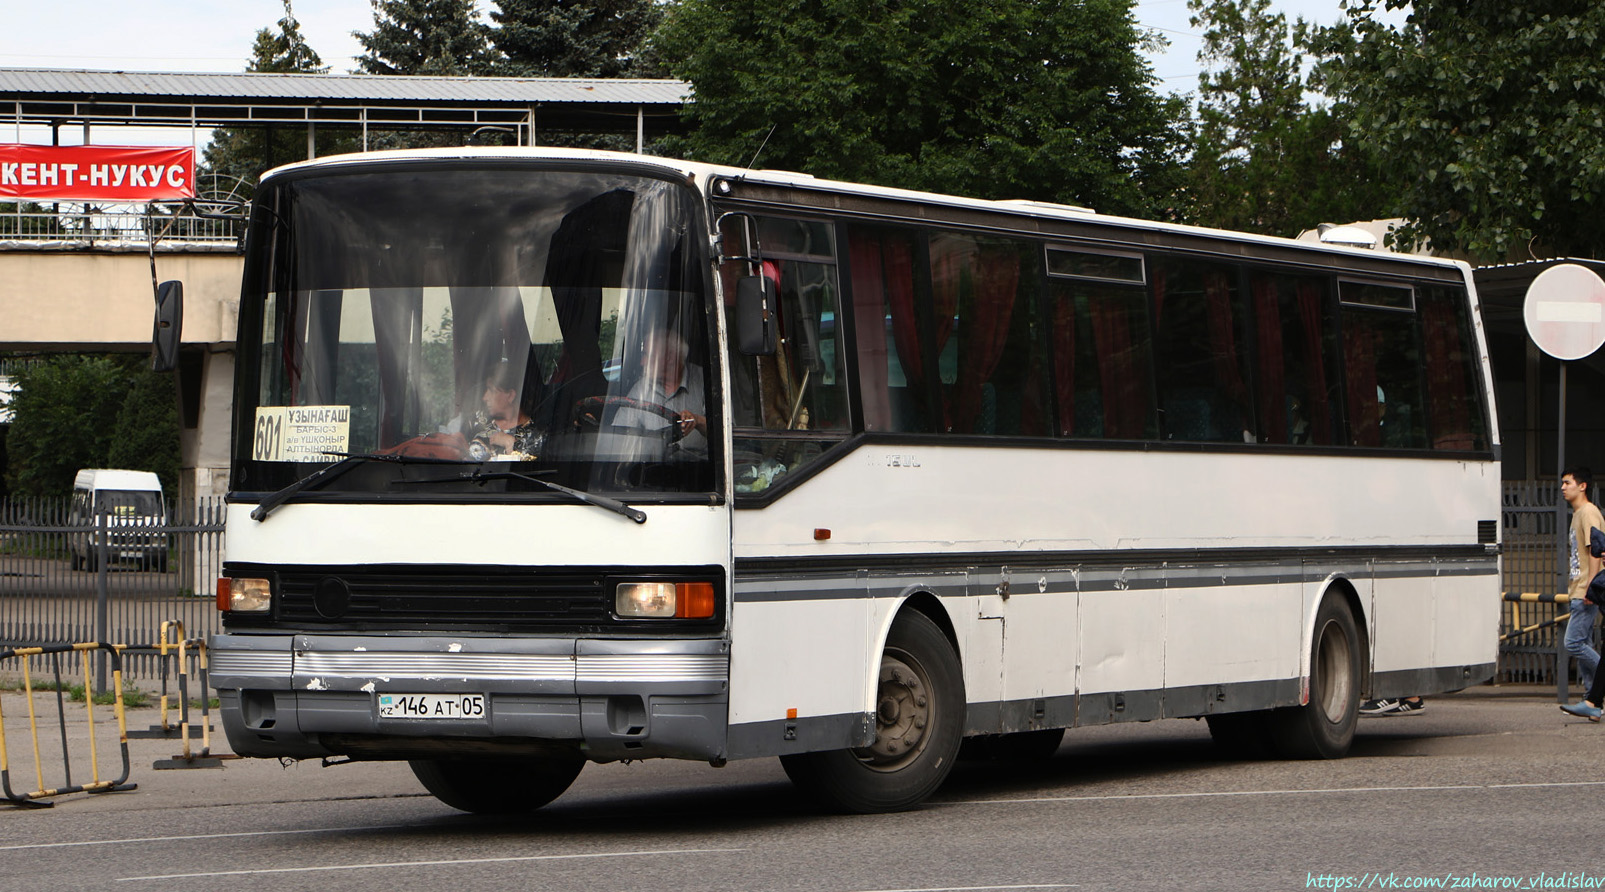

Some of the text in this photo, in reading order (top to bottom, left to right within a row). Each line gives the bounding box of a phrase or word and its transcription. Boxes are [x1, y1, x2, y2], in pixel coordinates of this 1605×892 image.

[1, 162, 185, 188] КЕНТ-НУКУС
[288, 409, 348, 424] ҰЗЫНАҒАШ
[255, 415, 282, 460] 601
[296, 425, 337, 434] БАРЫС-3
[380, 707, 393, 715] KZ
[398, 696, 483, 715] 146 AT 05
